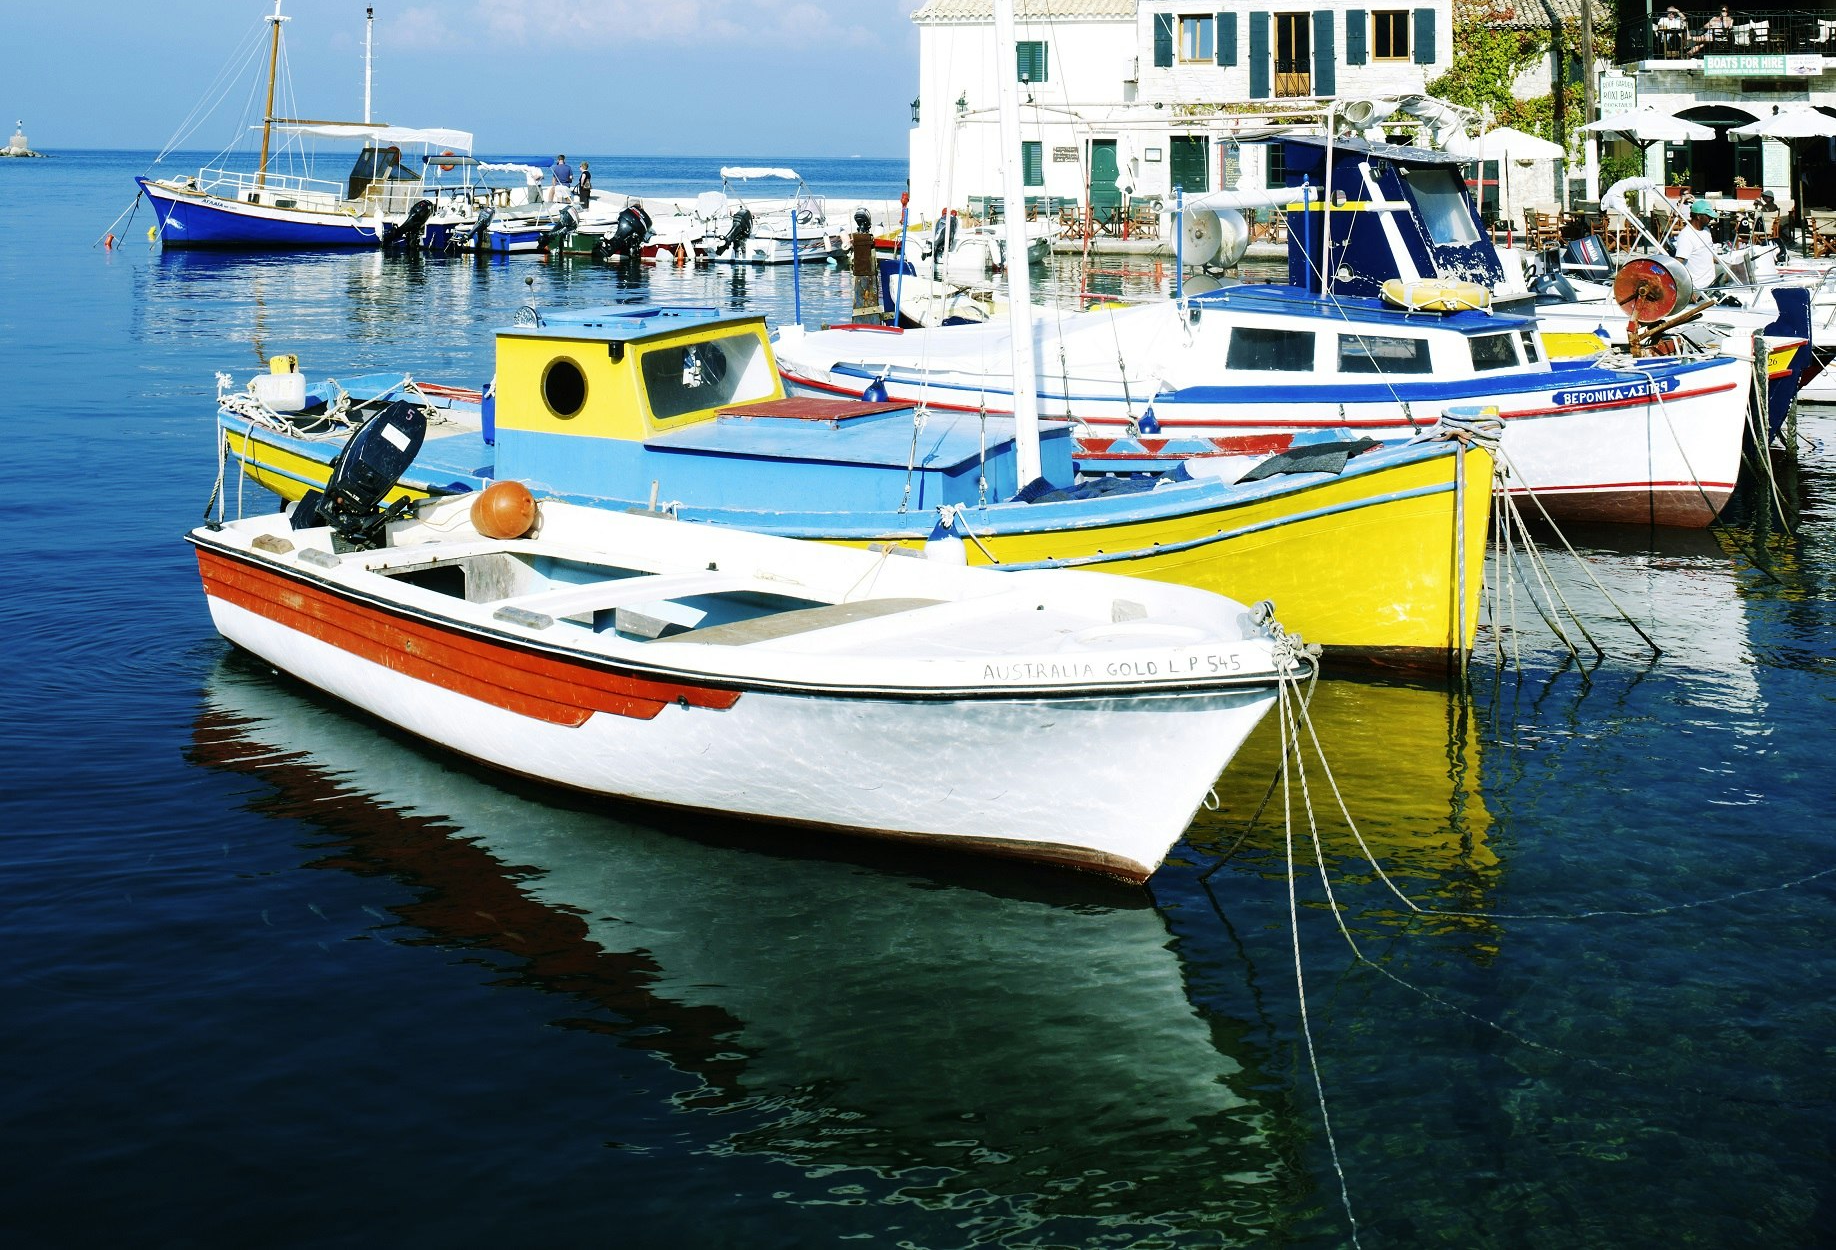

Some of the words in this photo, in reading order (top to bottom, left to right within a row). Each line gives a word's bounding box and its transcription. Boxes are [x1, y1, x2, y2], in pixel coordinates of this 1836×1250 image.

[1707, 57, 1738, 69] BOATS
[1740, 56, 1759, 69] FOR
[1761, 56, 1784, 69] HIRE
[1620, 90, 1633, 101] BAR
[1767, 357, 1778, 367] 26
[405, 408, 416, 421] 5
[983, 662, 1094, 681] AUSTRALIA
[1106, 660, 1158, 677] GOLD
[1207, 653, 1242, 673] 545
